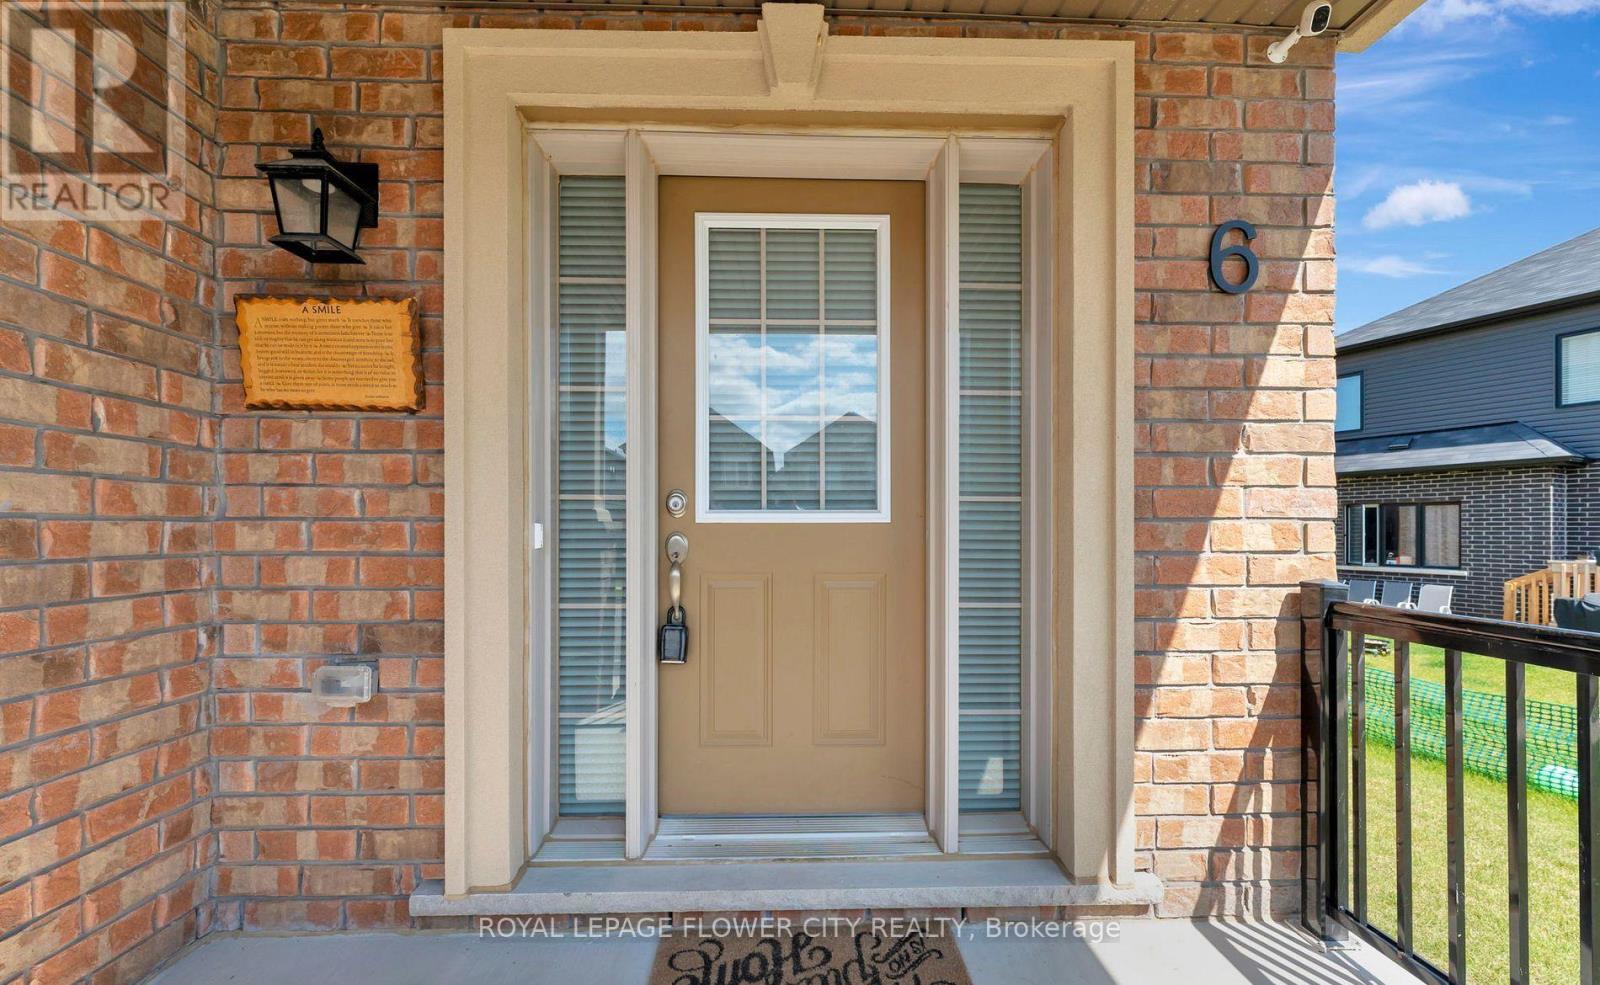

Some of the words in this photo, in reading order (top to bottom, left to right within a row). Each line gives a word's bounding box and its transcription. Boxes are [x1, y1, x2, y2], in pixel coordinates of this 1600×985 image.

[1209, 220, 1259, 294] 6
[302, 306, 309, 314] A
[312, 305, 342, 314] SMILE
